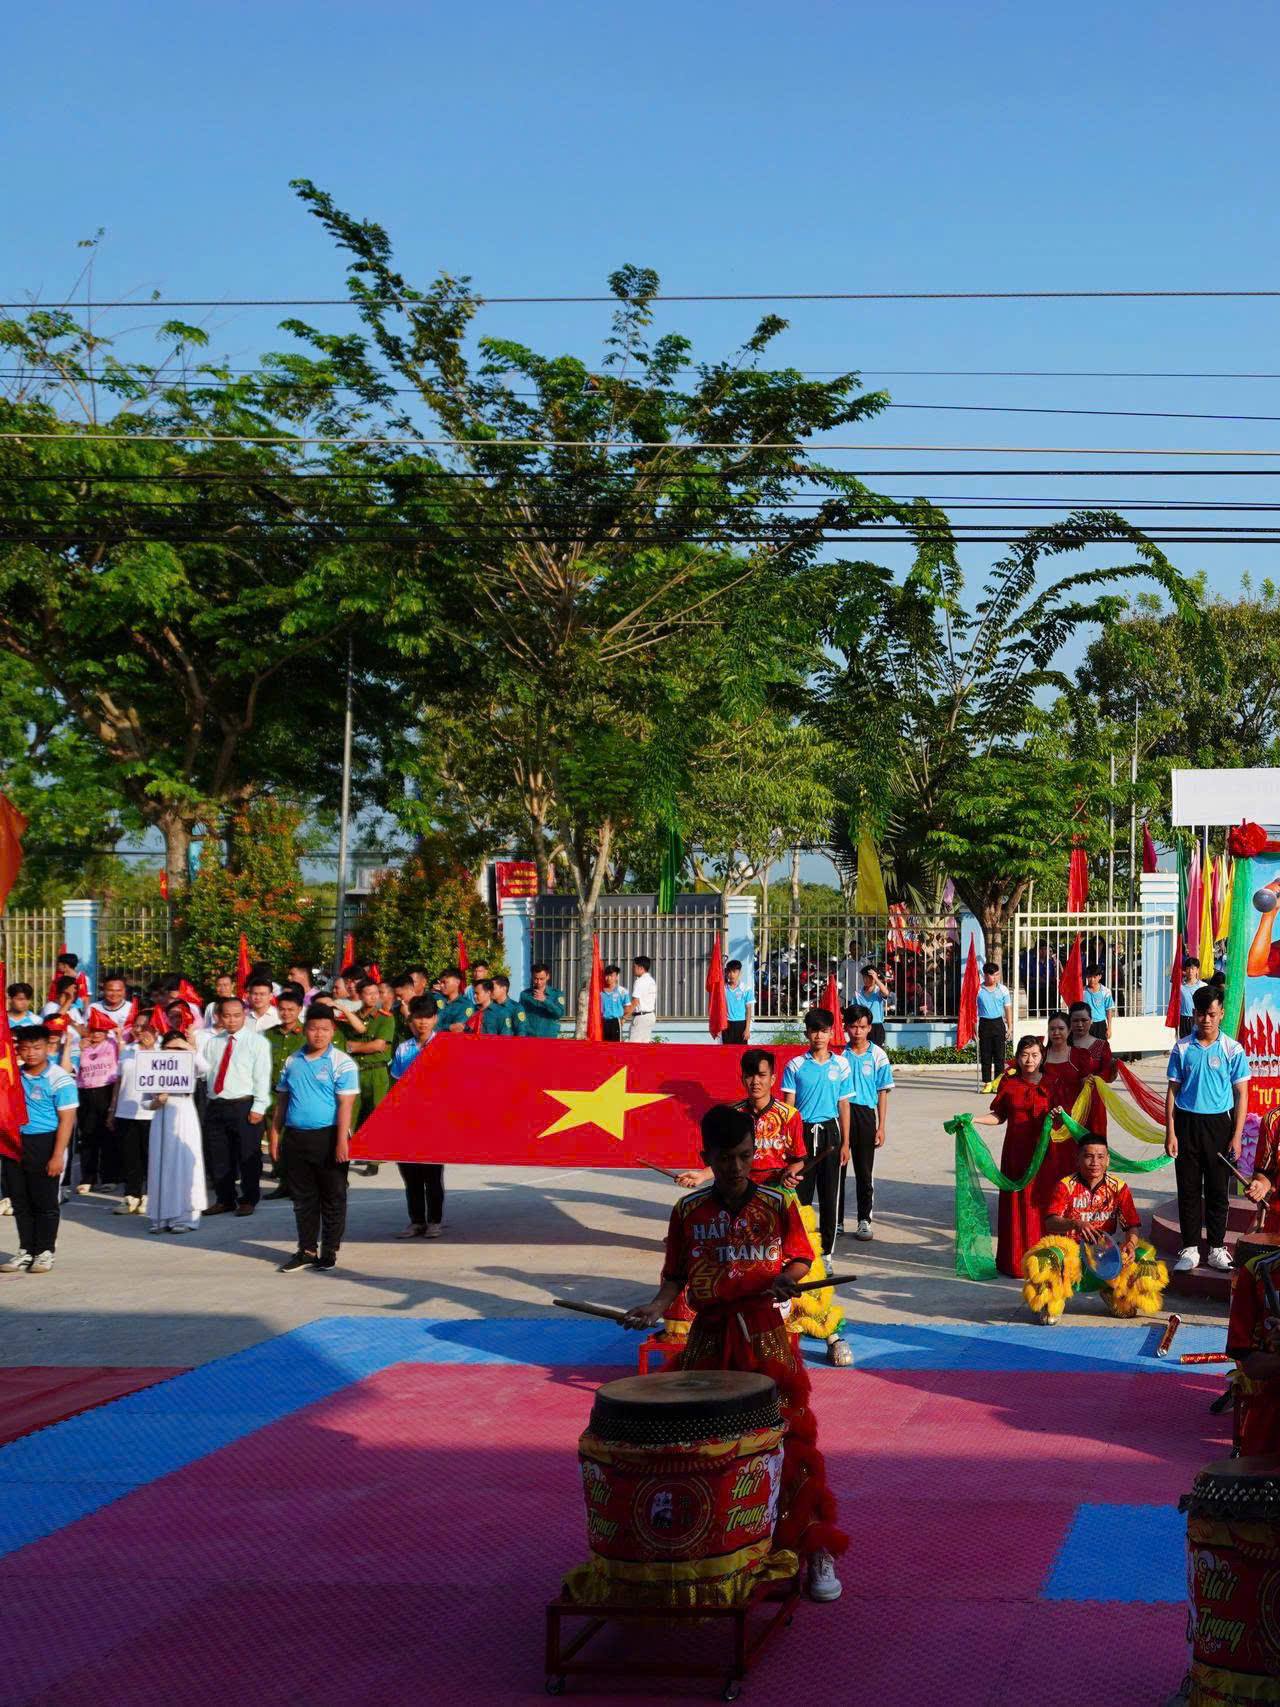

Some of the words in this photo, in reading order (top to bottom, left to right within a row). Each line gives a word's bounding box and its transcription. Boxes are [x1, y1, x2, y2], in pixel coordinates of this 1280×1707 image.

[151, 1055, 178, 1071] KHỐI
[139, 1075, 155, 1087] CƠ
[158, 1075, 189, 1088] QUAN
[717, 1244, 779, 1261] TRANG
[725, 1504, 767, 1534] Trang
